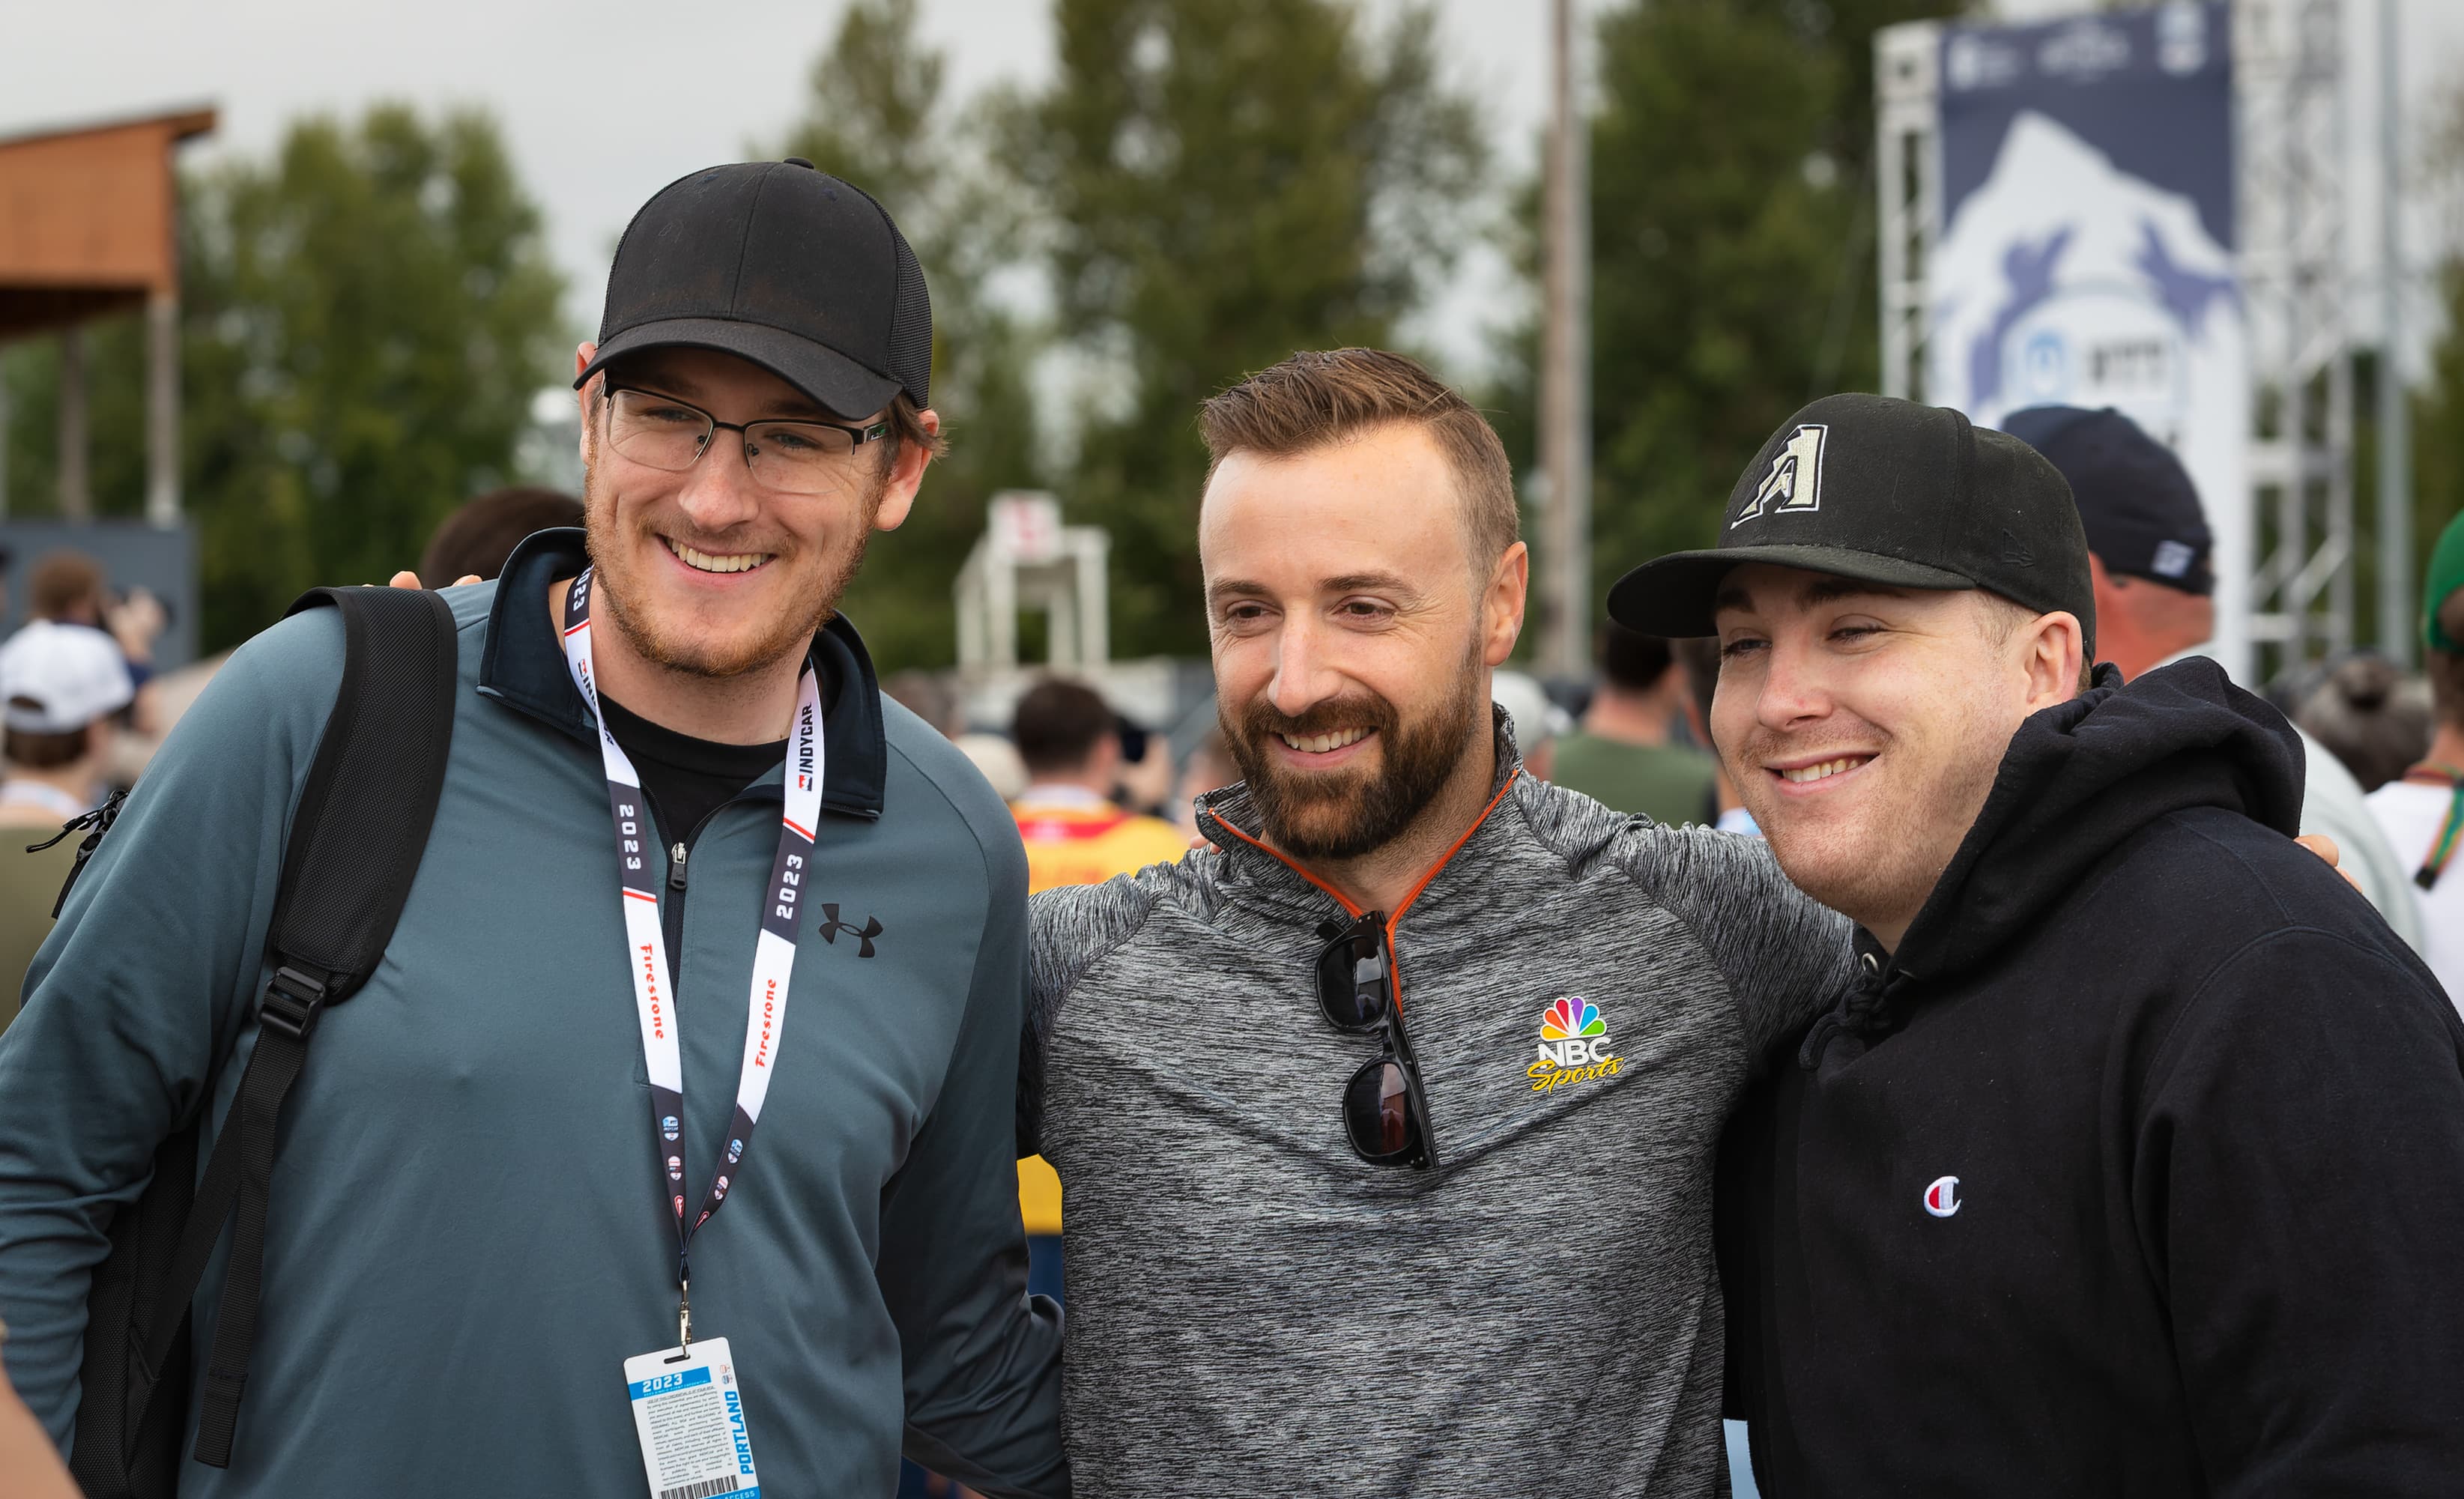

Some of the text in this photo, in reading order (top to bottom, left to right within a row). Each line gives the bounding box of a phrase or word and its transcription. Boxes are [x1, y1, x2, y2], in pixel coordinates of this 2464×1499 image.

[799, 702, 814, 774] INDYCAR
[619, 804, 642, 870] 2023
[776, 854, 803, 920] 2023
[640, 943, 665, 1040] Firestone
[755, 978, 777, 1068] Firestone
[1527, 1057, 1624, 1094] Sports
[1537, 1036, 1614, 1069] NBC
[643, 1373, 683, 1393] 2023
[724, 1390, 754, 1475] PORTLAND
